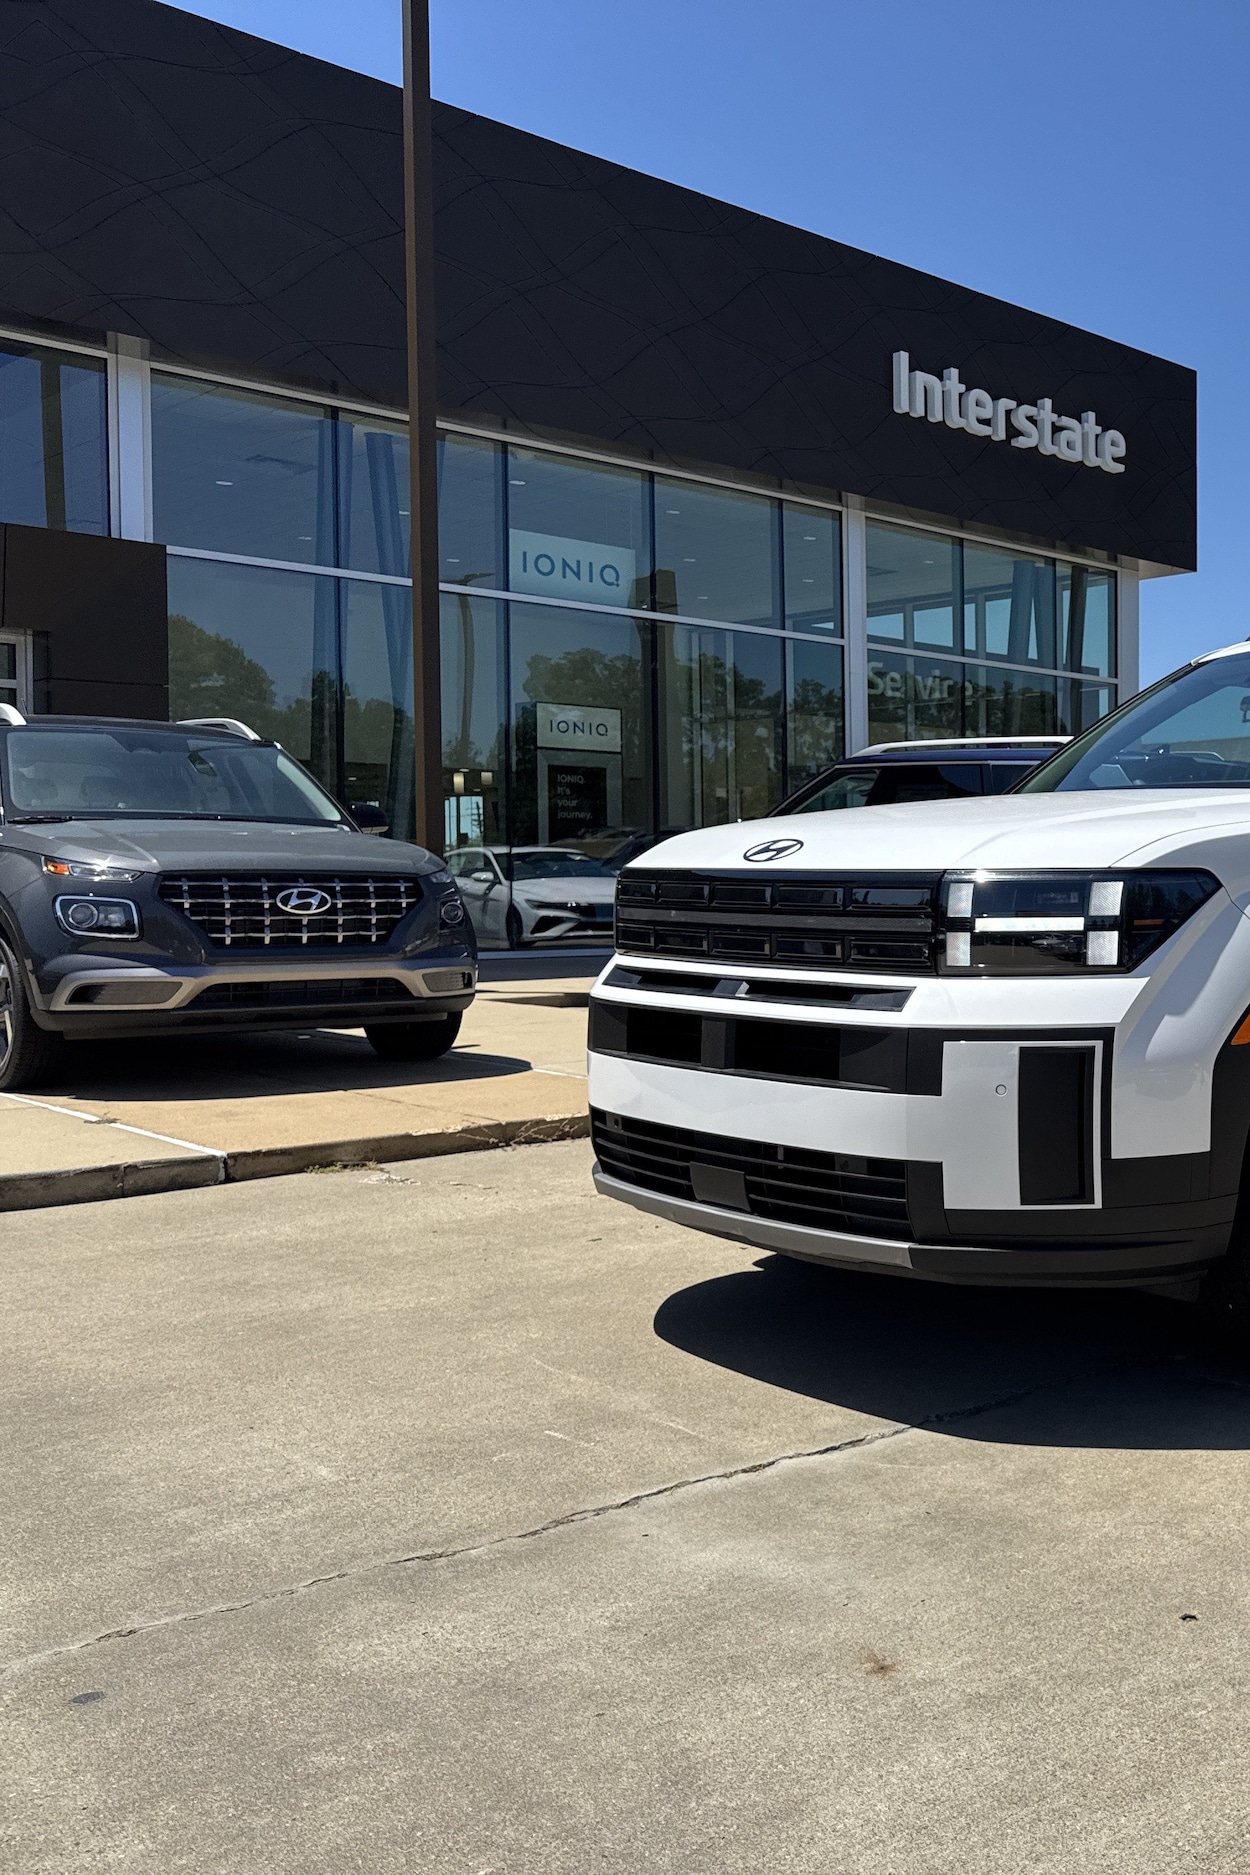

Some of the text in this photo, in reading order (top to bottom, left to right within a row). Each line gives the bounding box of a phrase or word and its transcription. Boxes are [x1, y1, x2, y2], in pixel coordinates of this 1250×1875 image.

[893, 351, 1126, 473] Interstate
[522, 550, 620, 587] IONIQ
[867, 661, 974, 705] Sevice
[549, 719, 609, 737] IONIQ
[557, 800, 577, 808] your
[557, 809, 593, 821] journey.
